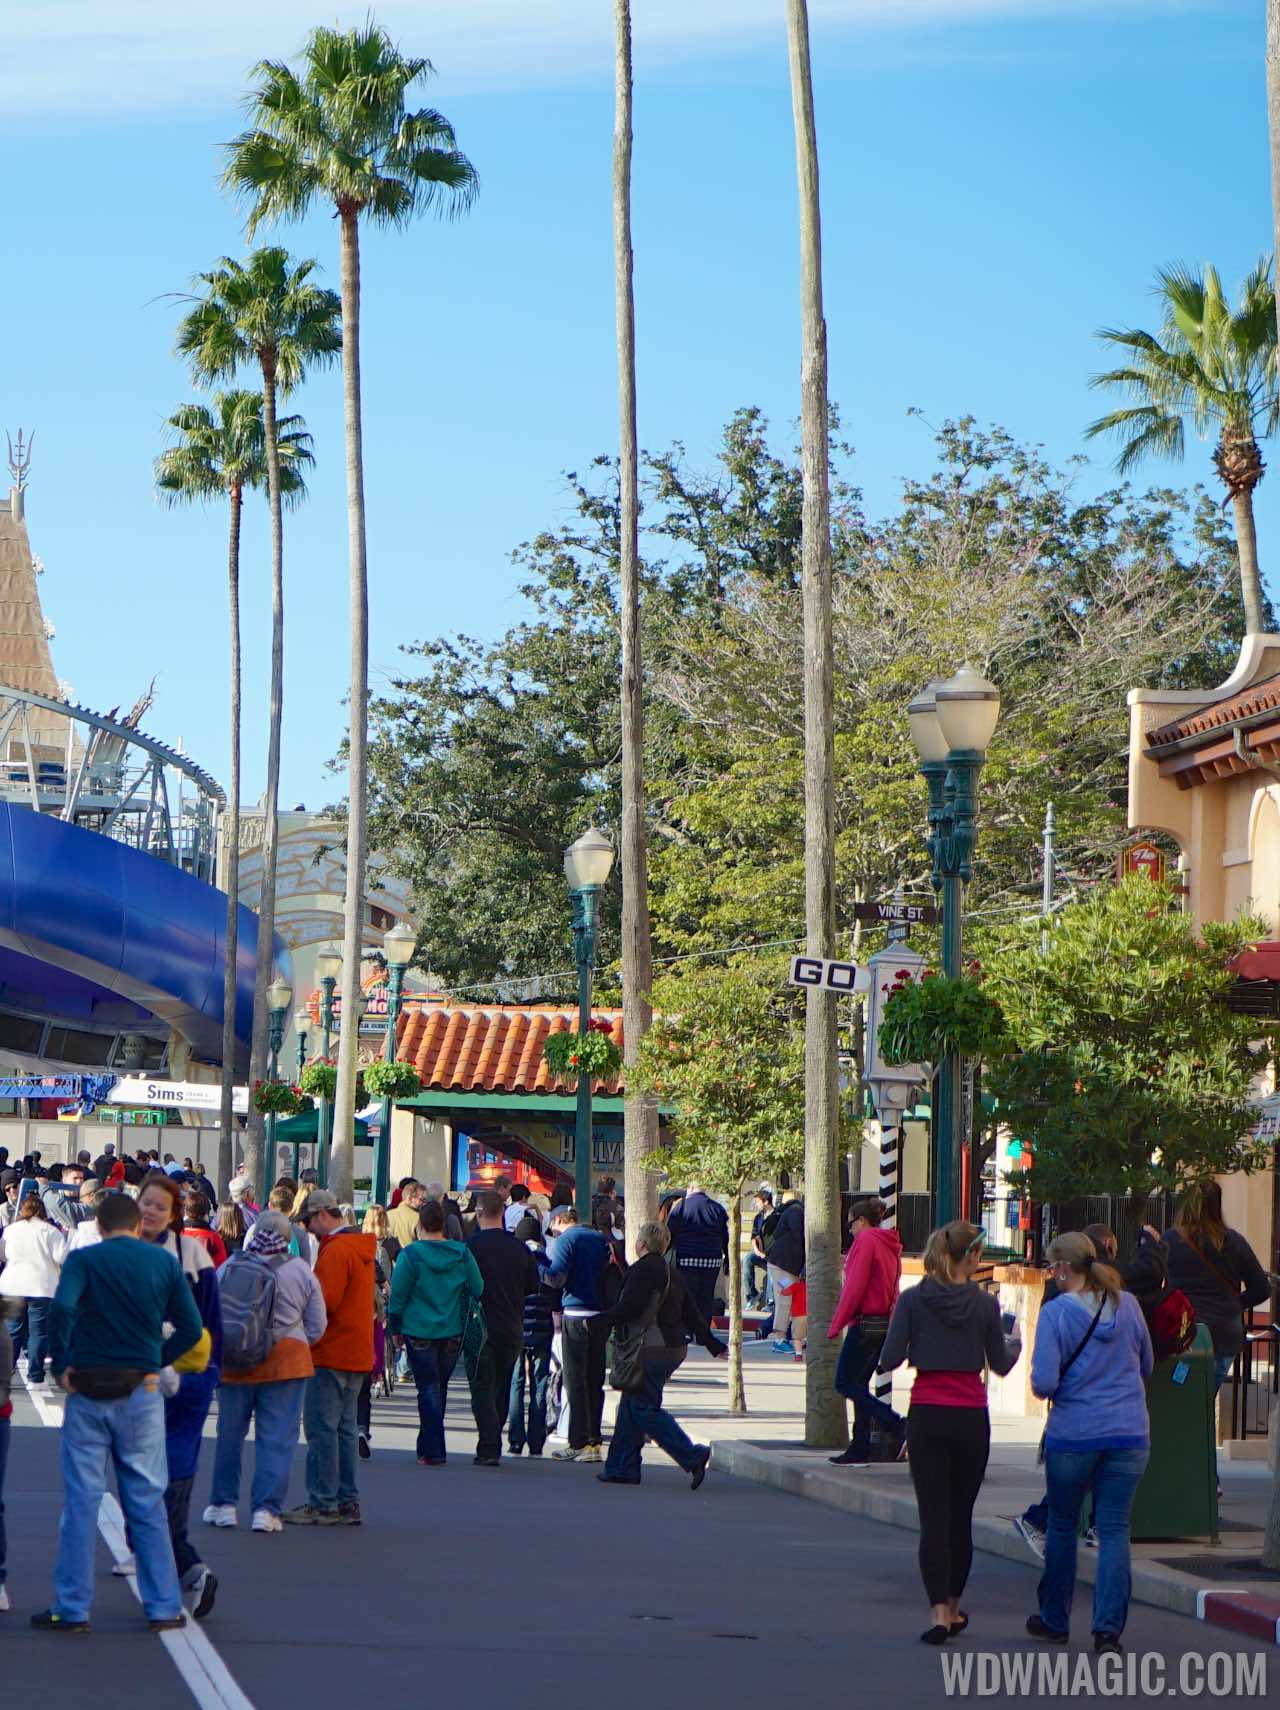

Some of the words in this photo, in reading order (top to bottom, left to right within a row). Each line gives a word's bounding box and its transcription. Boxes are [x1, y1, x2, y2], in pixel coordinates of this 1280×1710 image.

[878, 905, 904, 918] VINE
[907, 907, 924, 919] ST.
[794, 957, 856, 990] GO
[147, 1084, 184, 1101] Sims
